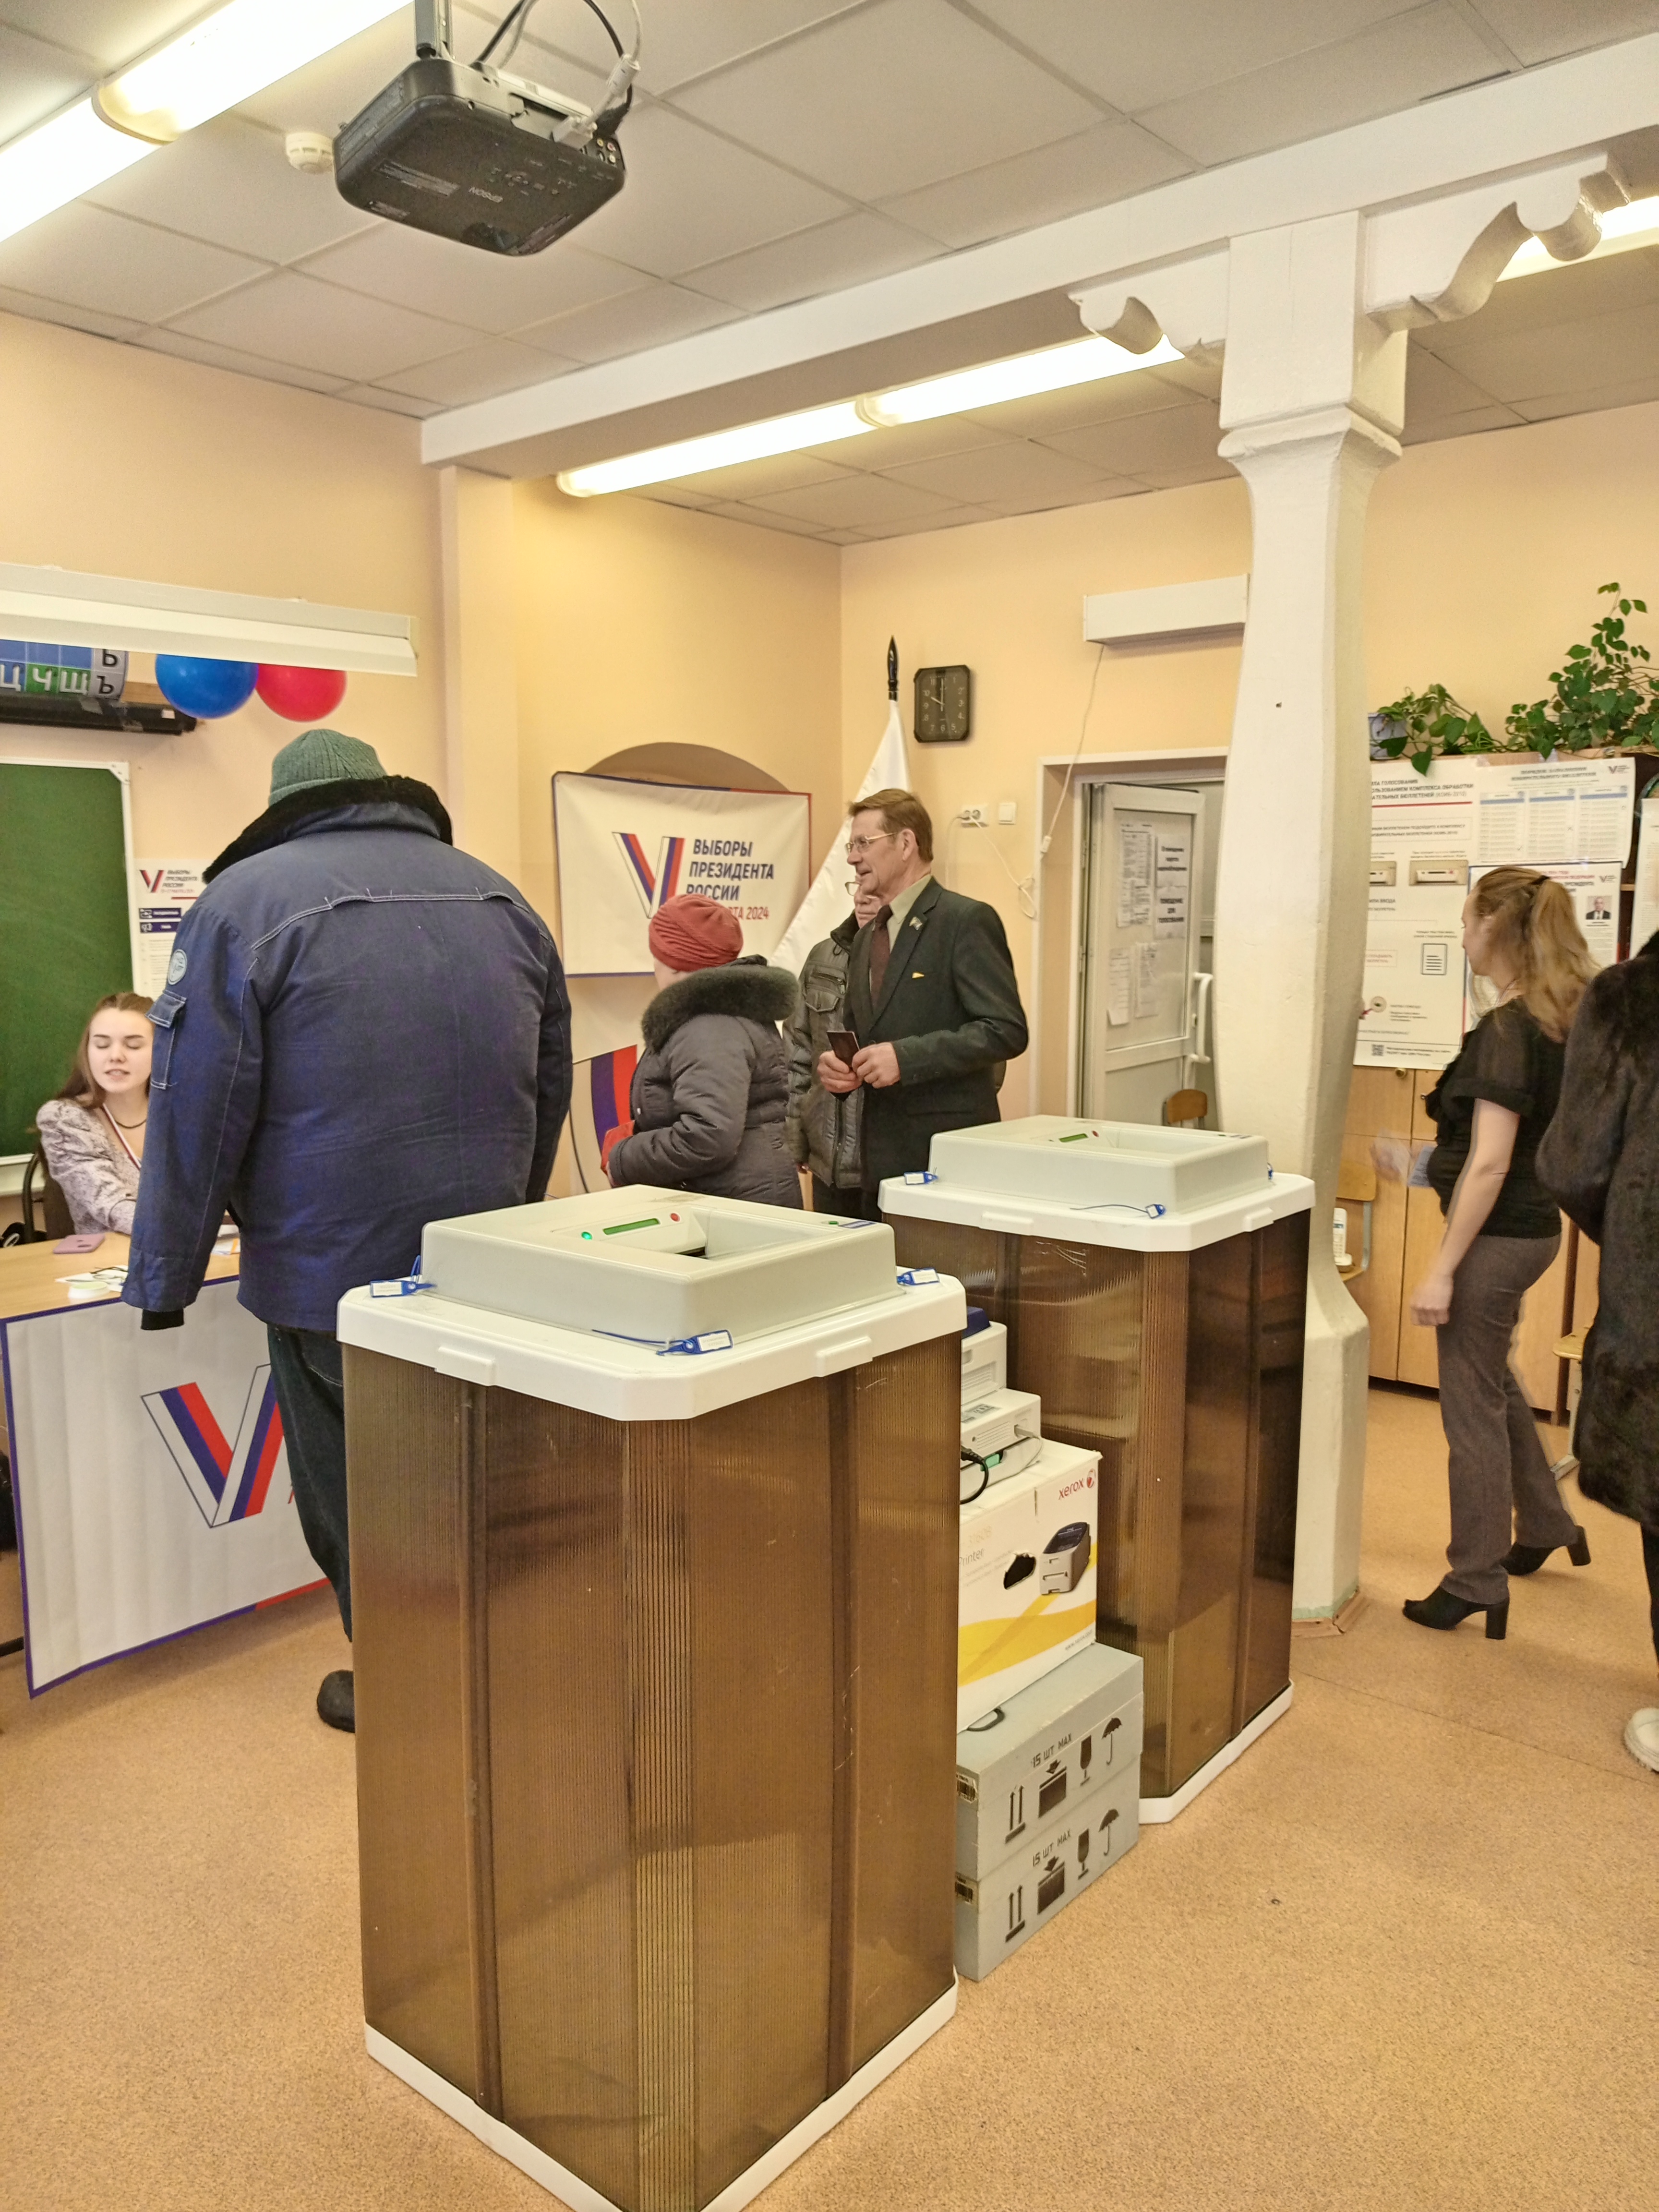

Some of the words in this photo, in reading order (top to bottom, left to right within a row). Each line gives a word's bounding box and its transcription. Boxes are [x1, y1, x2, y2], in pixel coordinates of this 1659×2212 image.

[32, 668, 53, 691] Ч
[97, 675, 115, 694] Ъ
[693, 839, 753, 857] ВЫБОРЫ
[689, 861, 774, 880] ПРЕЗИДЕНТА
[746, 906, 769, 920] 2024
[1058, 1478, 1084, 1501] xerox
[1033, 1752, 1041, 1767] 15
[1043, 1745, 1055, 1761] ШТ
[1033, 1852, 1040, 1867] 15
[1043, 1842, 1054, 1859] ШТ
